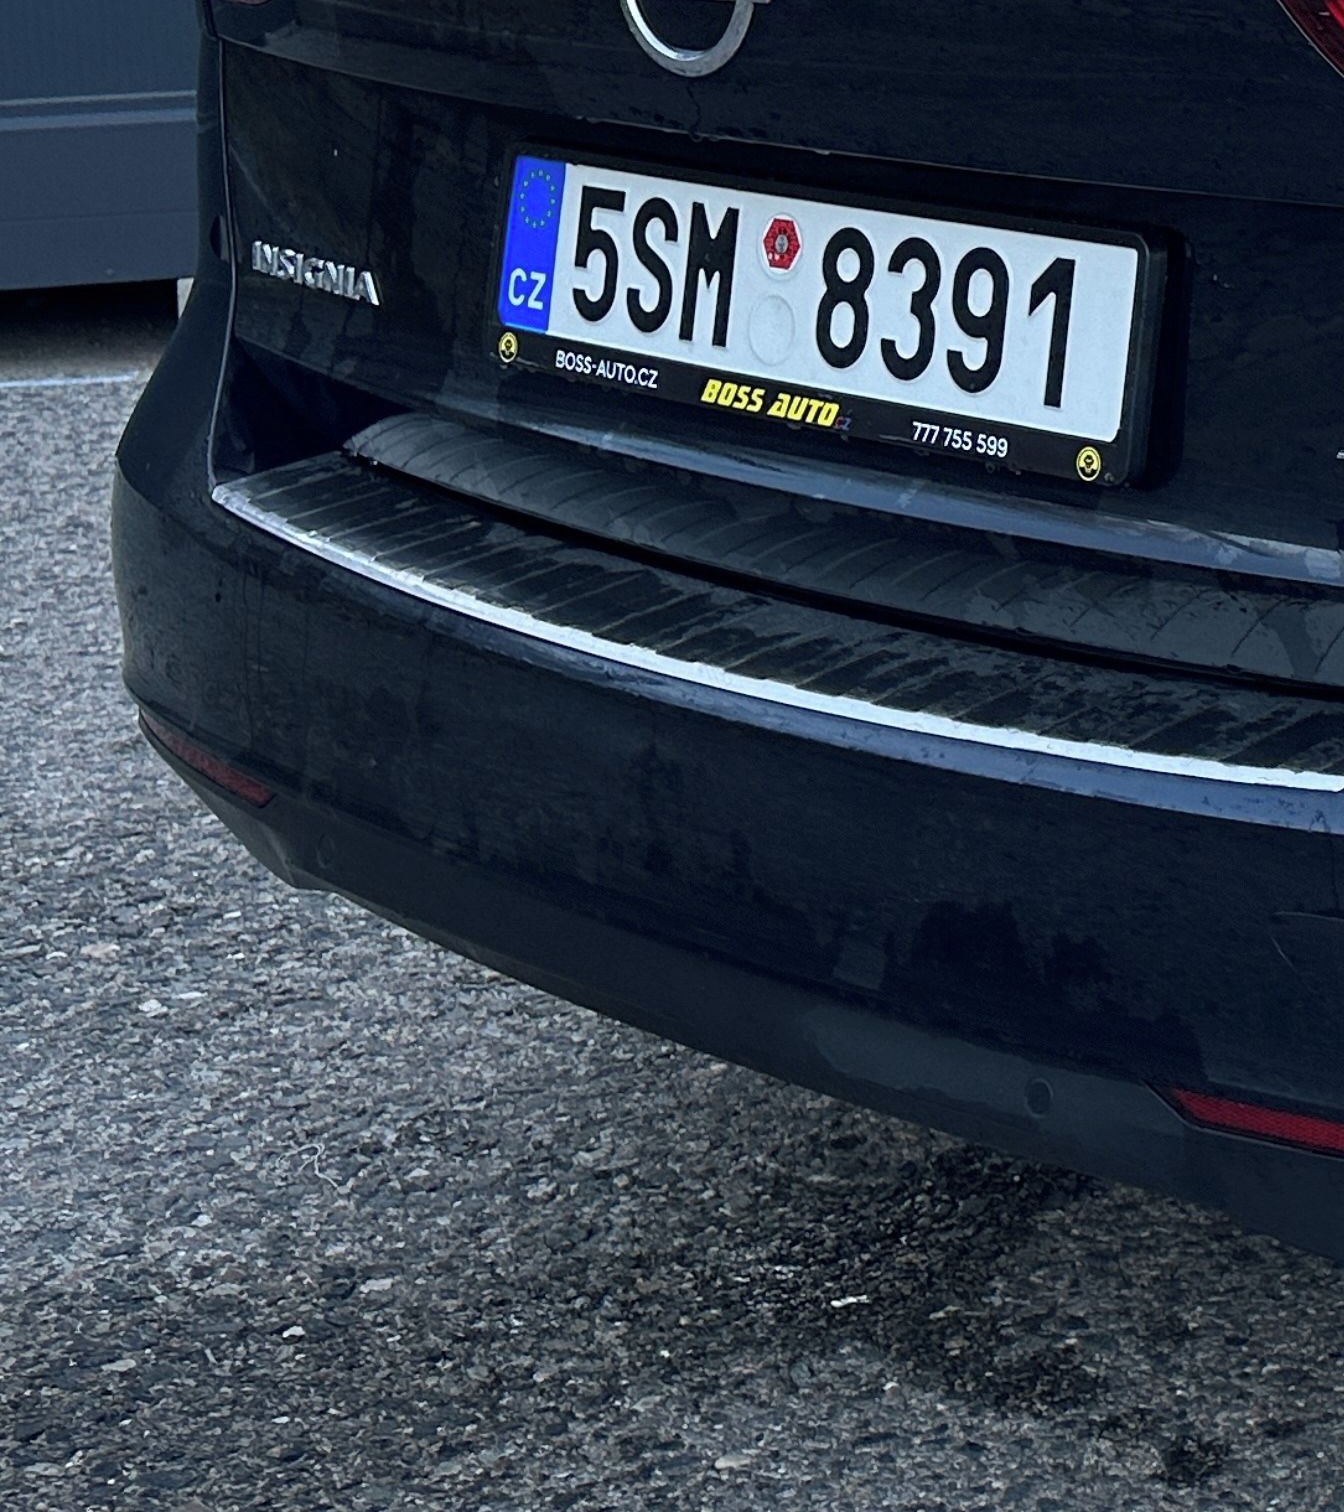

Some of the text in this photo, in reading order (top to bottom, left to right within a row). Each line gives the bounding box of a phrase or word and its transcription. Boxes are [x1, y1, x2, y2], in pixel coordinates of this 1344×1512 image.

[252, 241, 380, 306] INSIGNIA
[508, 267, 546, 310] CZ
[573, 186, 1076, 409] 5SM 8391
[555, 350, 658, 388] BOSS-AUTO.CZ
[701, 379, 765, 413] BOSS
[767, 393, 839, 427] AUTO
[912, 421, 1008, 458] 777 755 599
